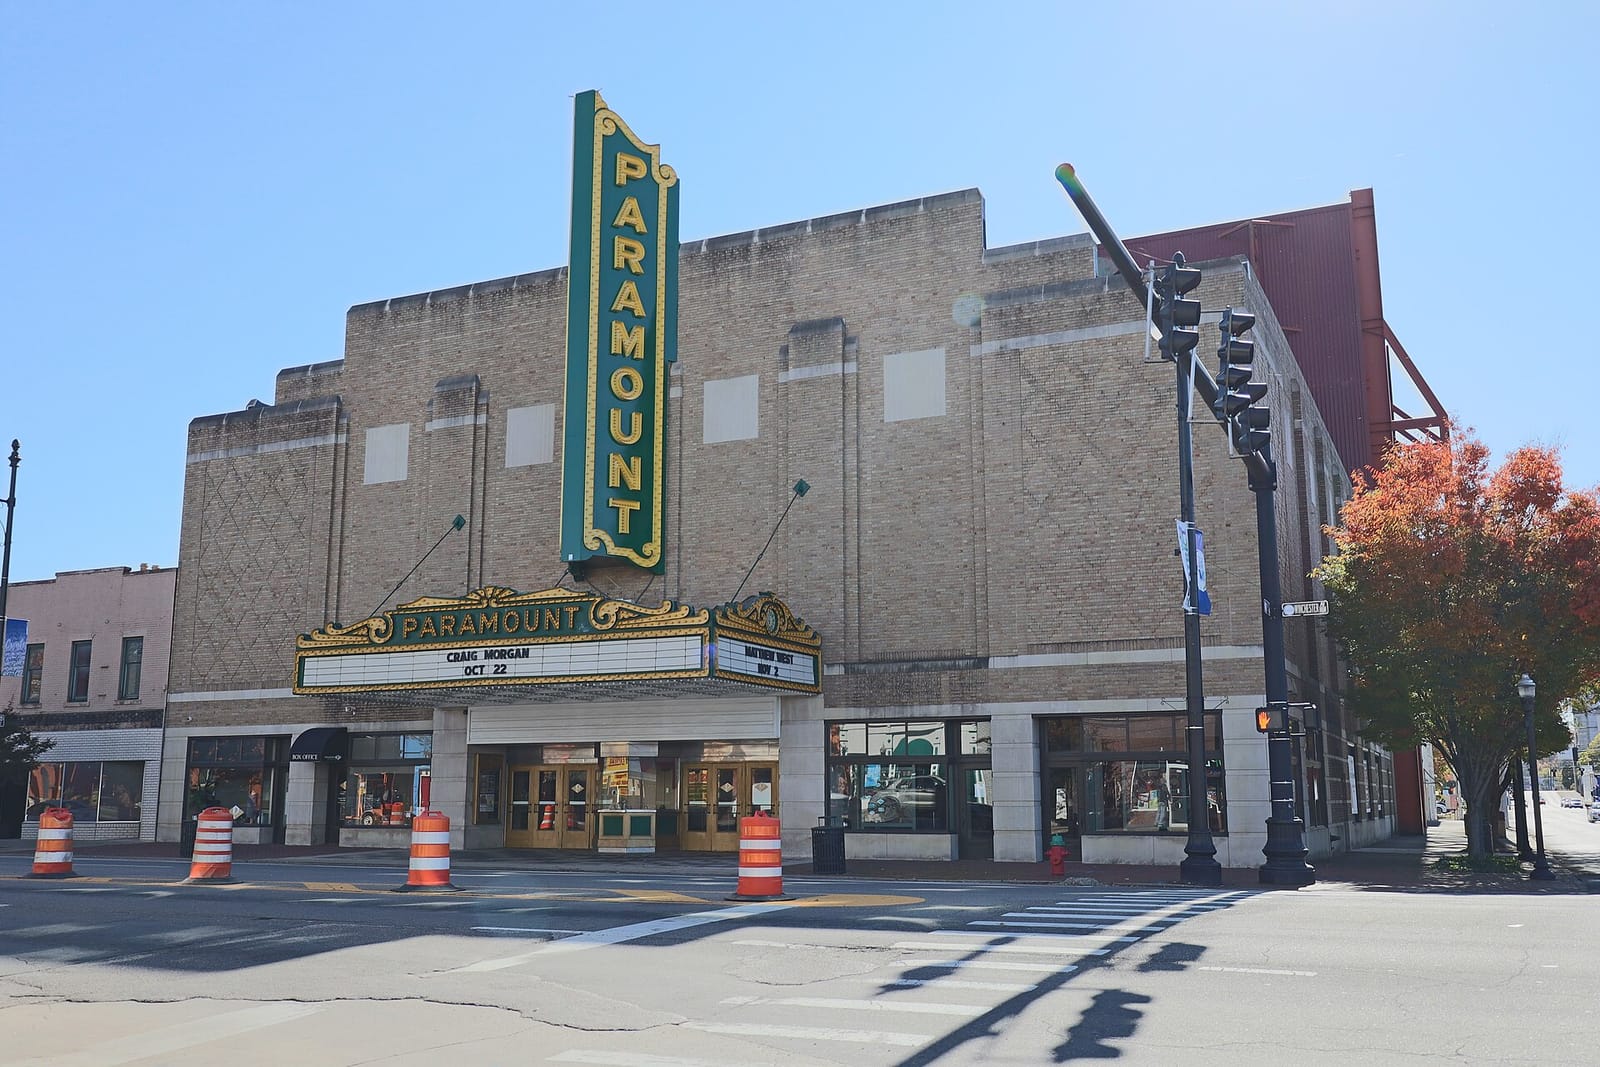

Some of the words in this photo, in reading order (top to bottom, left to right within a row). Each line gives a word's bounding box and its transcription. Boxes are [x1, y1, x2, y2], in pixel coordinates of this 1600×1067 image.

[608, 151, 648, 535] PARAMOUNT
[403, 606, 580, 638] PARAMOUNT
[446, 651, 478, 662] CRAIG
[484, 648, 530, 660] MORGAN
[776, 652, 794, 665] WEST
[464, 665, 485, 676] OCT
[493, 664, 507, 675] 22
[757, 663, 771, 675] NOV
[774, 666, 779, 676] 2
